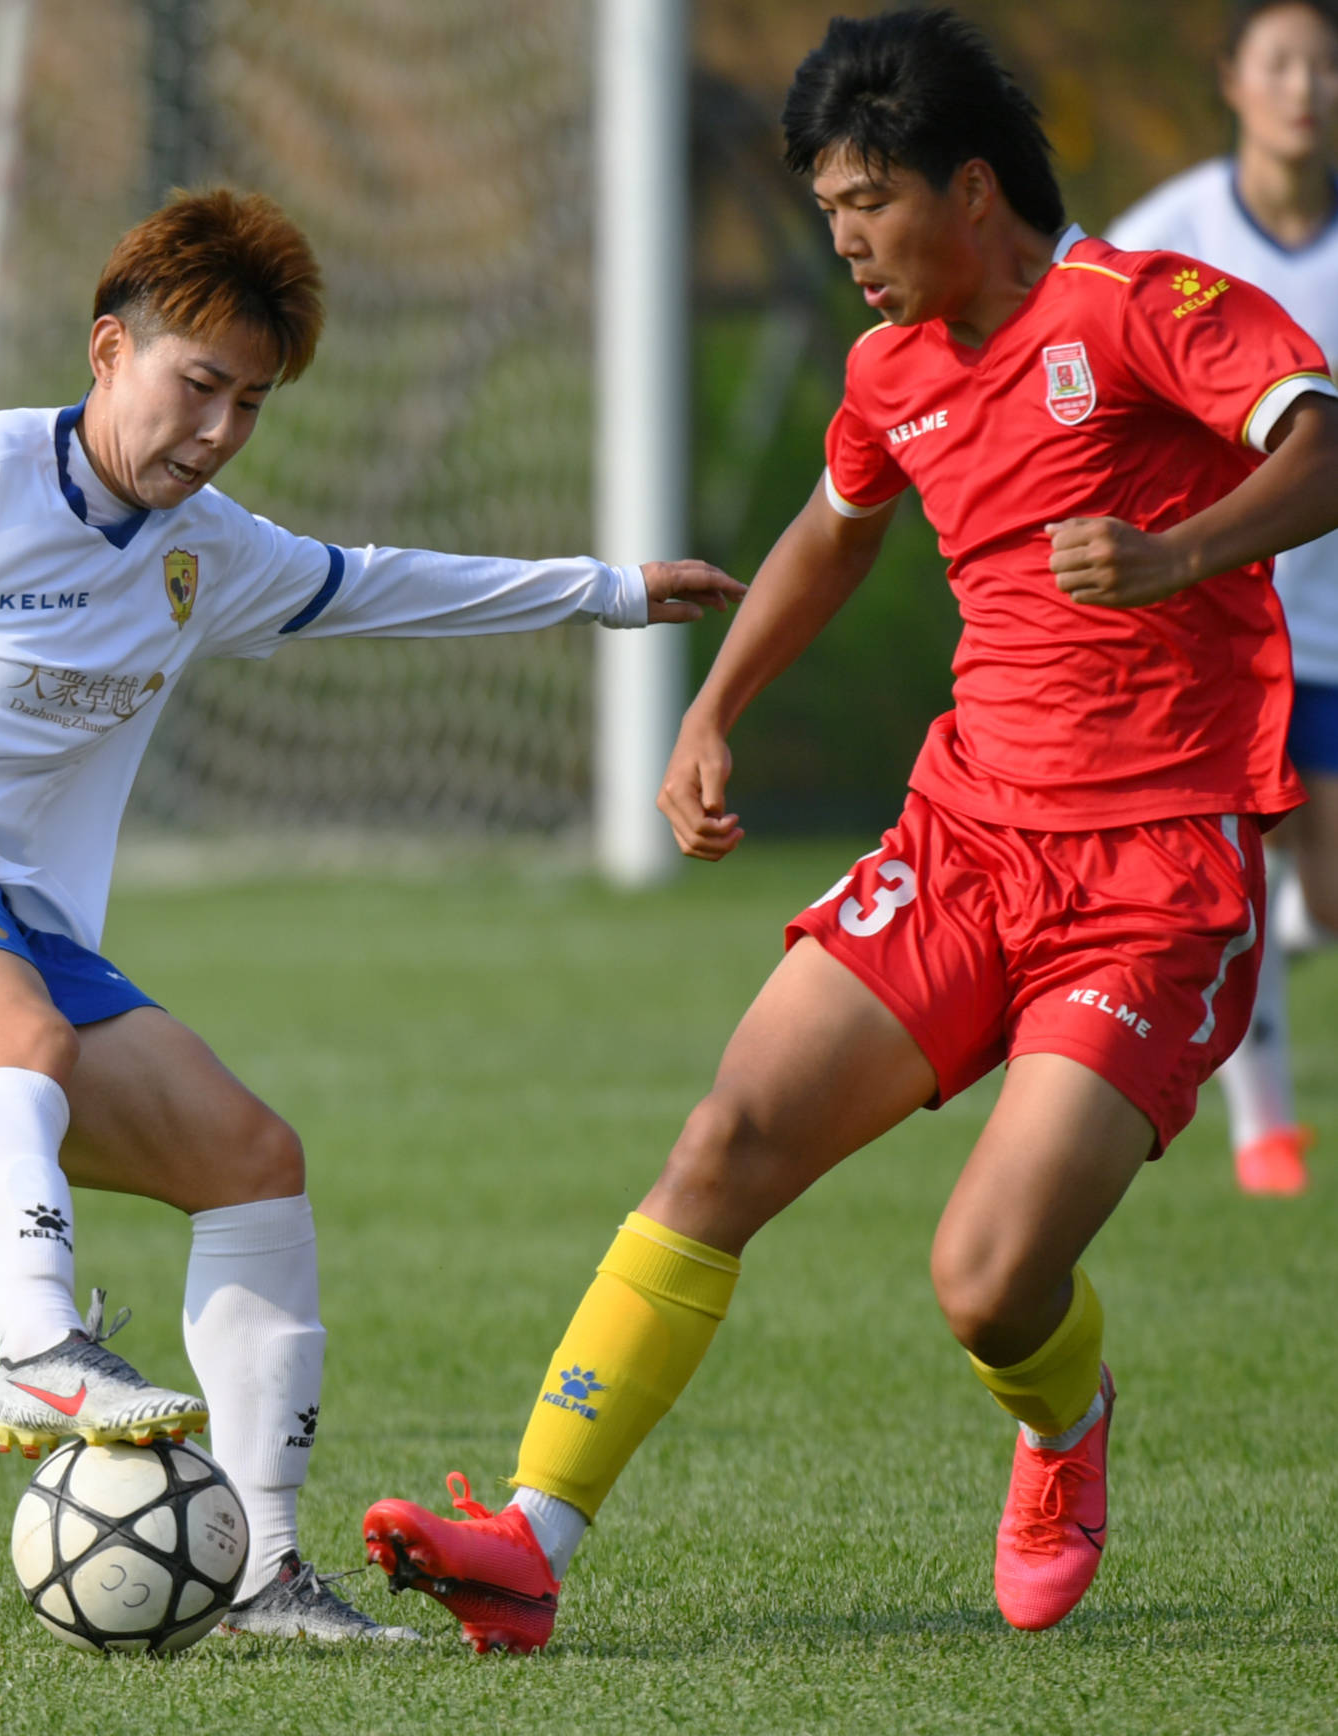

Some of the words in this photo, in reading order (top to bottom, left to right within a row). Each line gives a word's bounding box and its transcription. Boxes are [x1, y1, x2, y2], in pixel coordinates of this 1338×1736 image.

[1172, 278, 1230, 319] KELME
[886, 409, 949, 445] KELME
[1066, 988, 1152, 1039] KELME
[542, 1391, 599, 1421] KELME
